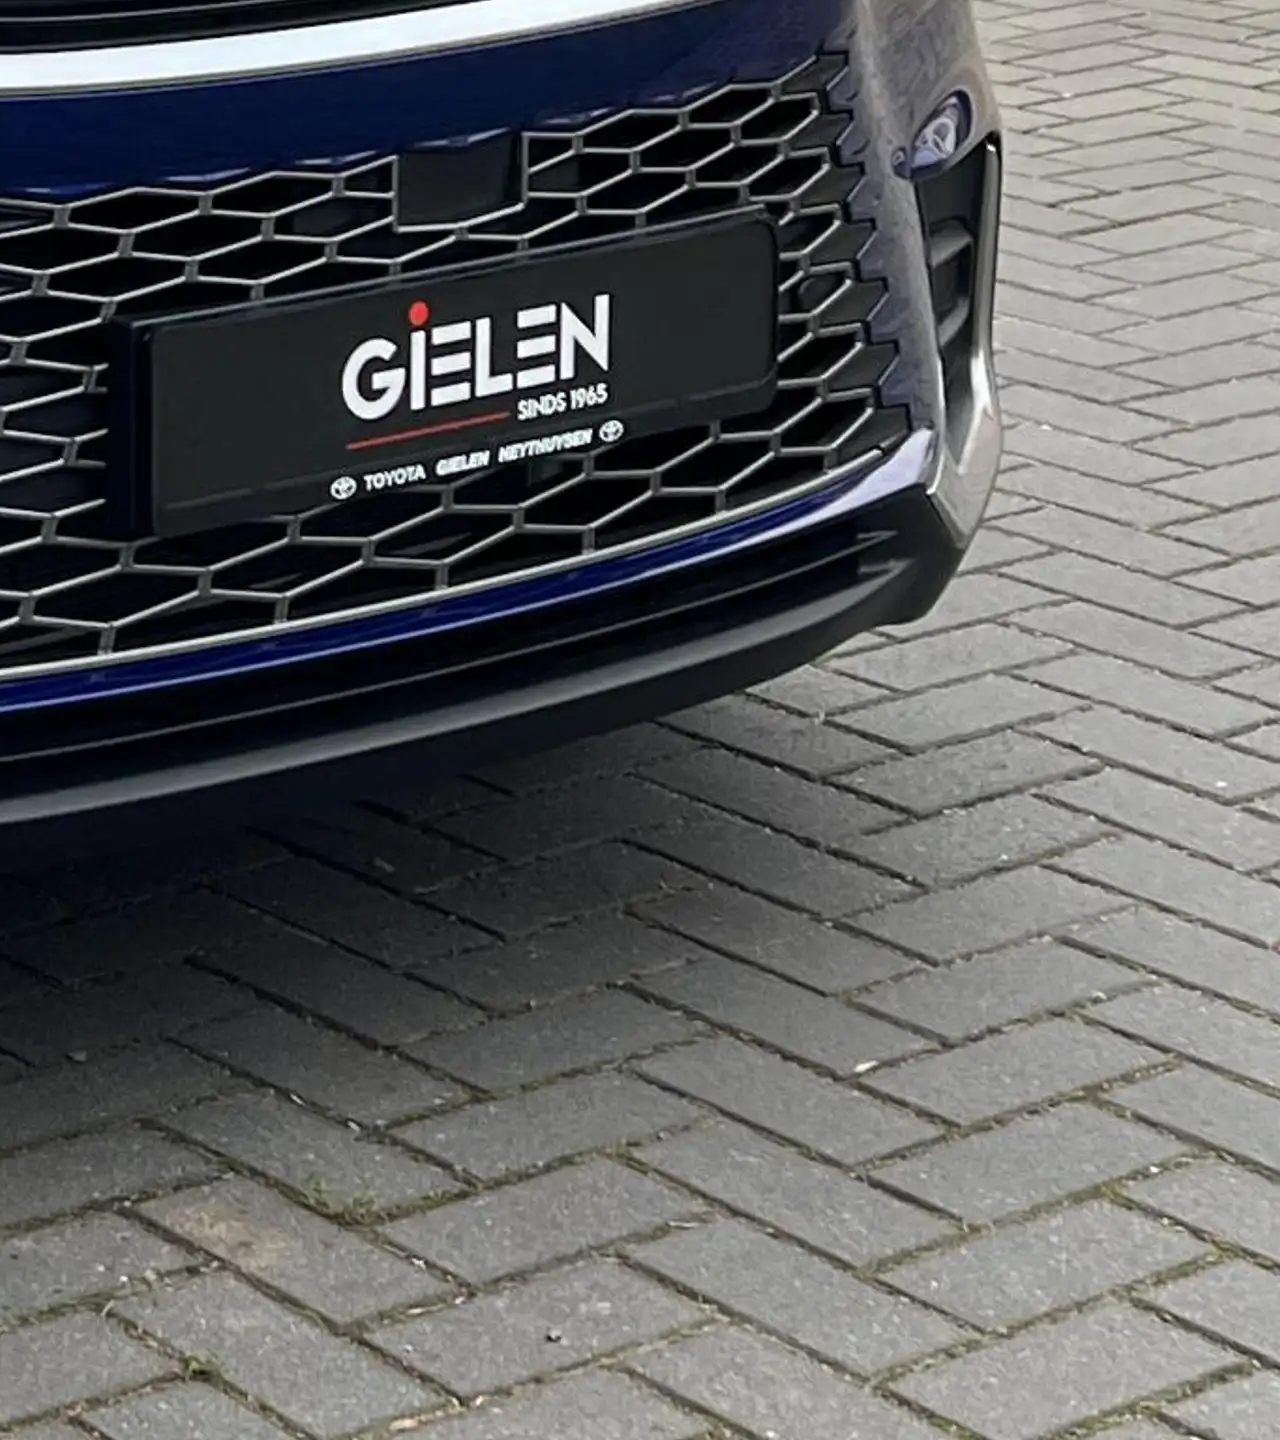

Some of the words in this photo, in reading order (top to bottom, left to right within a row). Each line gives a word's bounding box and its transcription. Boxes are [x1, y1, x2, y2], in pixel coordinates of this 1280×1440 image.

[516, 391, 567, 421] SINDS
[570, 383, 609, 412] 1965
[363, 464, 427, 492] TOYOTA
